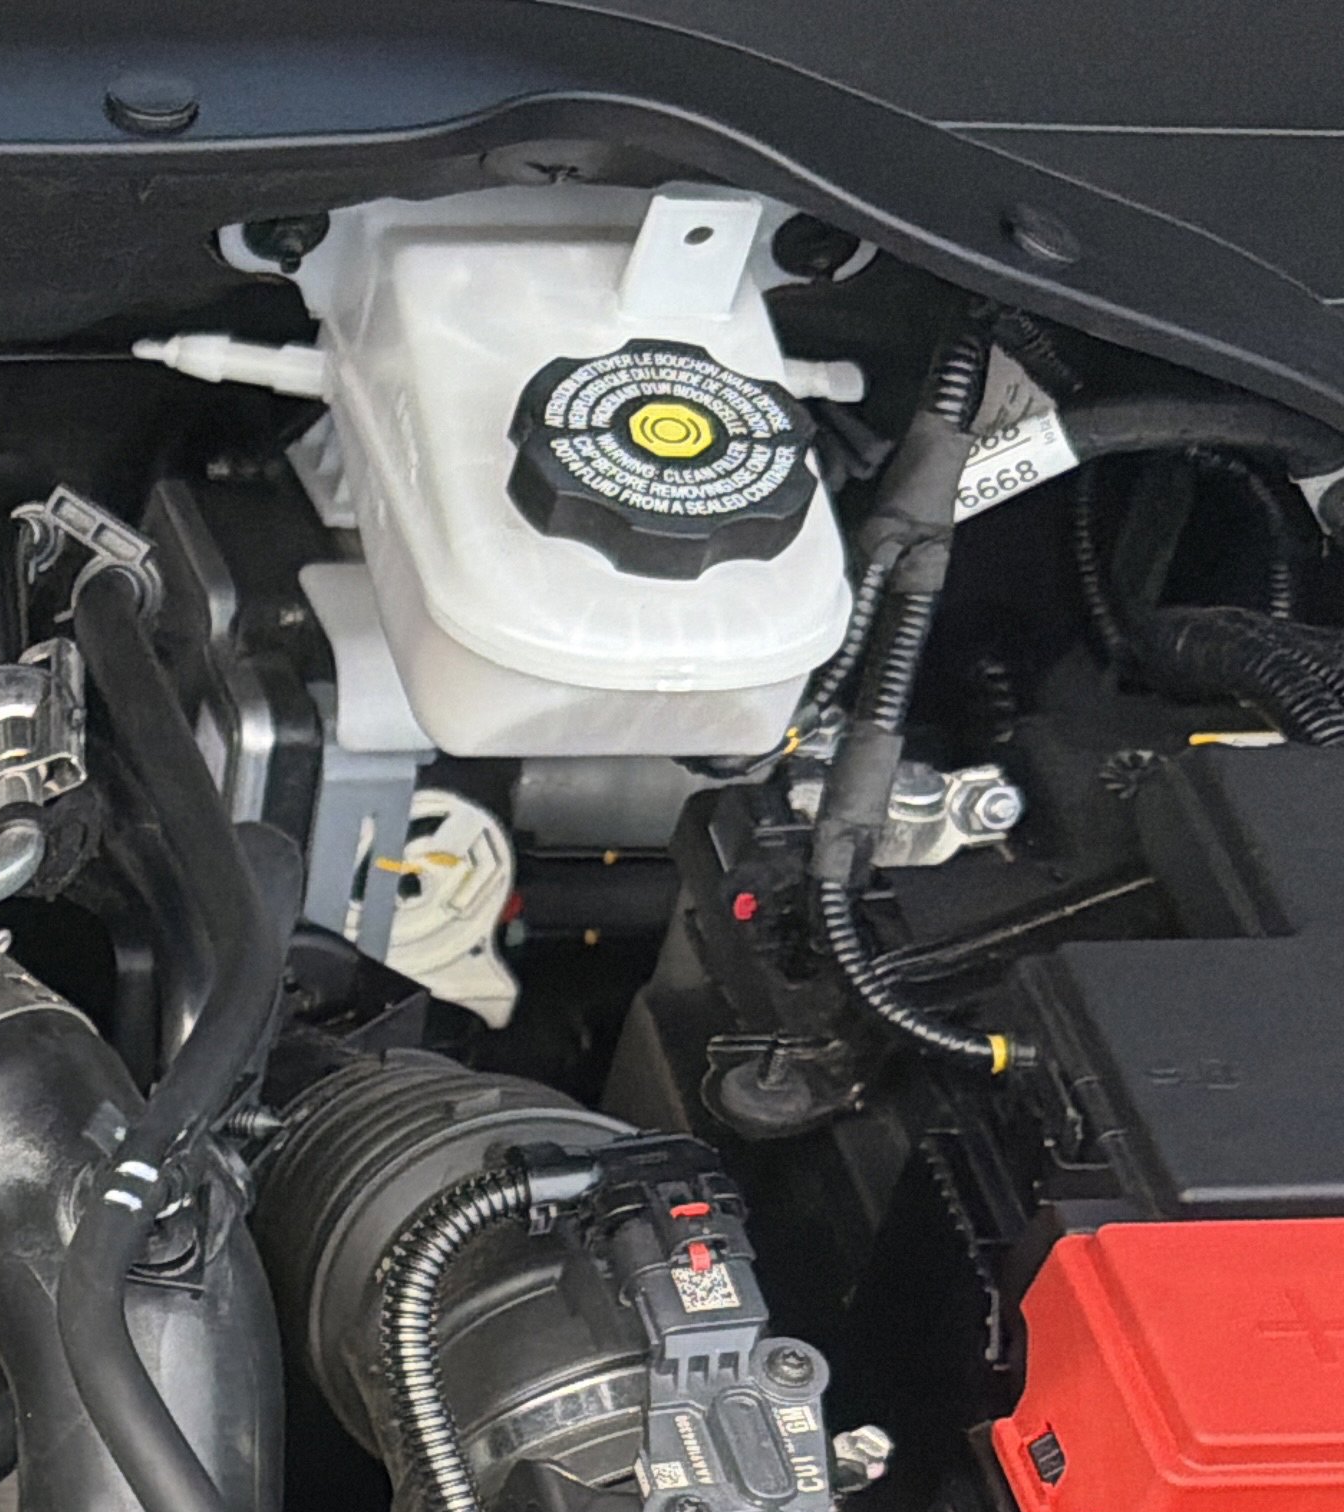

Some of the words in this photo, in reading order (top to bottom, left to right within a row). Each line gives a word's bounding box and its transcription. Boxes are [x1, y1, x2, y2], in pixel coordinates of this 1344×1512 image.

[633, 352, 653, 366] LE
[654, 353, 721, 378] BOUCHON
[717, 370, 762, 398] AVANT
[651, 367, 702, 387] LIQUIDE
[701, 377, 723, 394] DE
[572, 435, 602, 459] CAP
[591, 457, 650, 493] BEFORE
[663, 465, 717, 484] CLEAN
[711, 440, 749, 475] FILLER
[957, 459, 1039, 509] 6668
[574, 466, 622, 497] FLUID
[618, 489, 670, 514] FROM
[670, 500, 685, 515] A
[685, 493, 749, 516] SEALED
